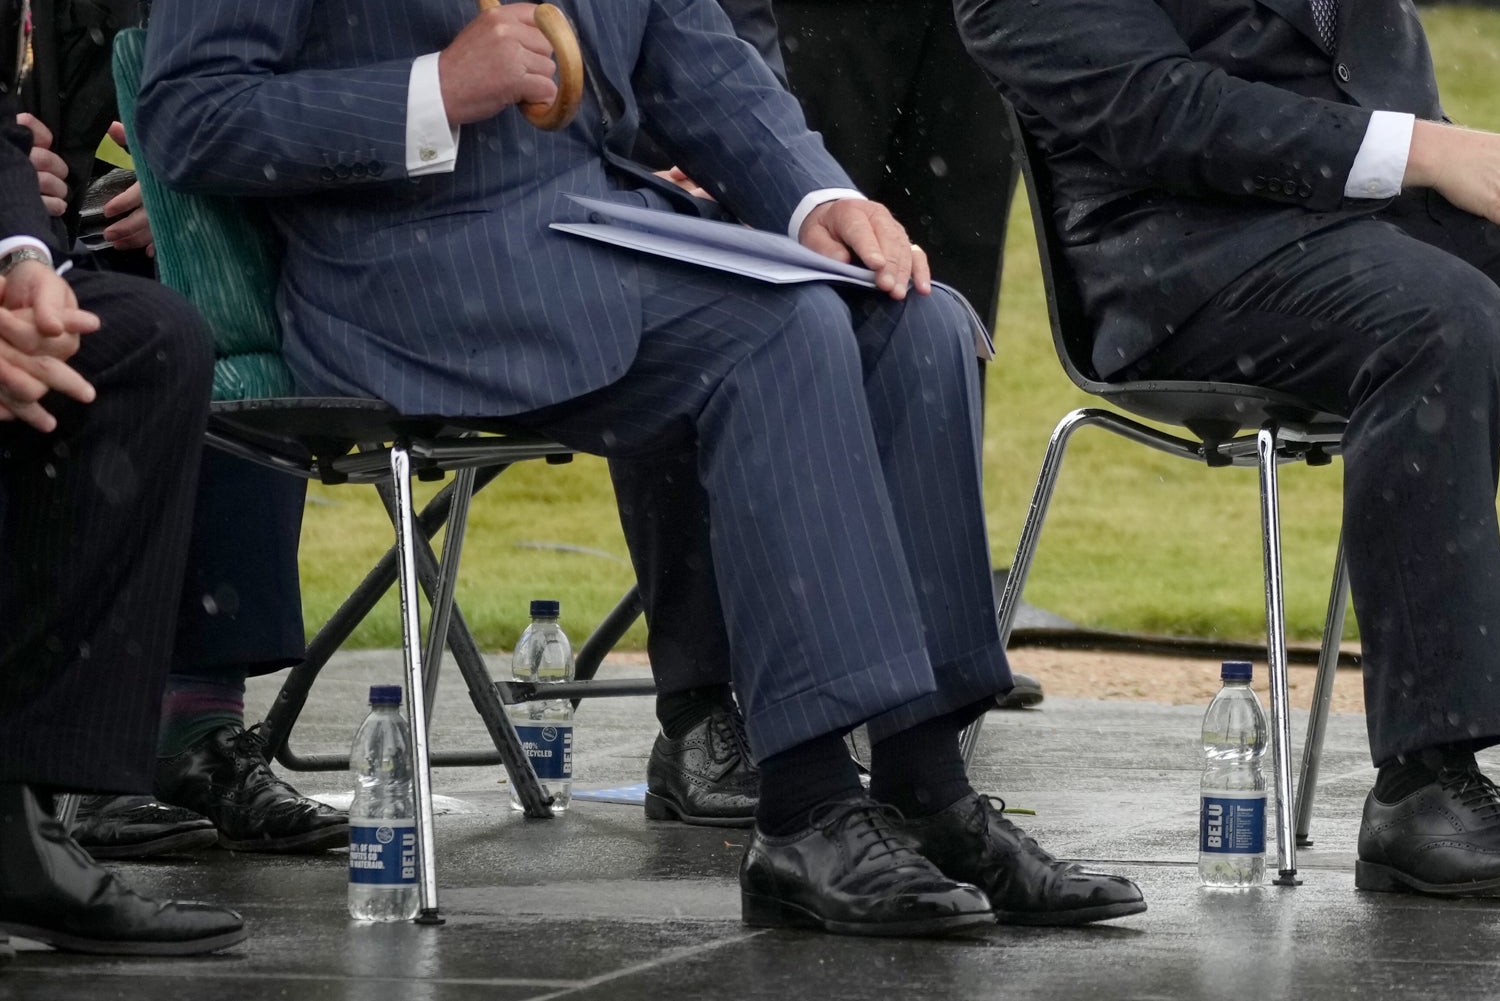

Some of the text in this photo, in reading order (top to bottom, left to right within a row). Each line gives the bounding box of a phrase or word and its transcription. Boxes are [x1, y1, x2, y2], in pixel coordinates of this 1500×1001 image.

[563, 733, 571, 773] BELU
[1208, 804, 1222, 848] BELU
[402, 833, 415, 878] BELU
